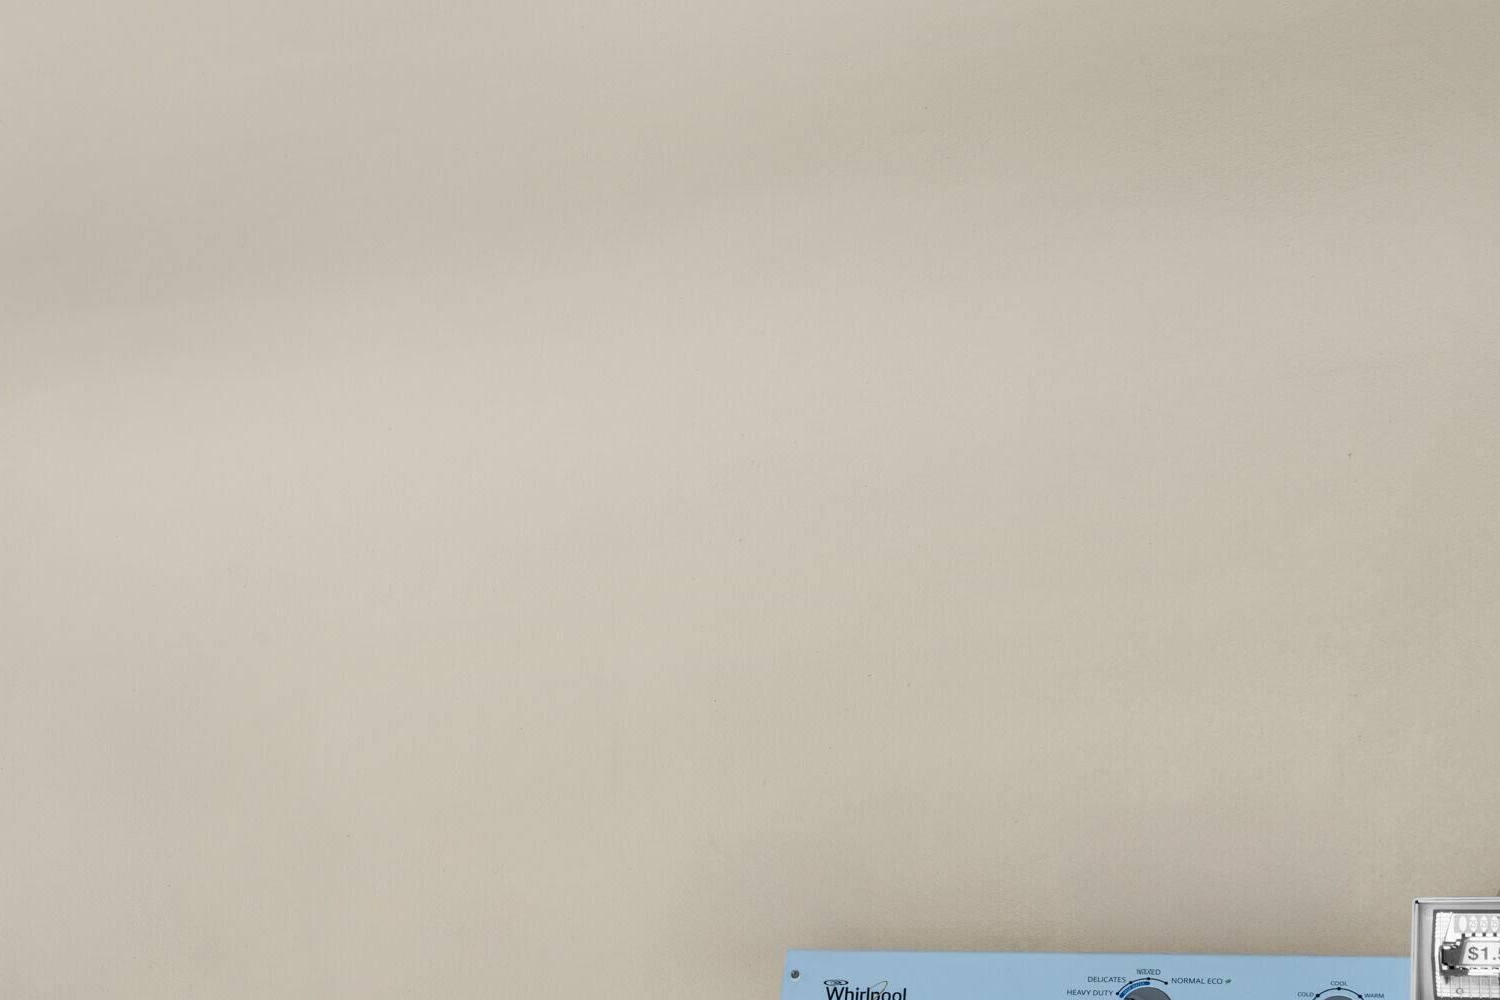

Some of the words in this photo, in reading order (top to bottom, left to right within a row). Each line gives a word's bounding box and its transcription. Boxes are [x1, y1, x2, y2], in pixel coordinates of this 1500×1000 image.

[1468, 946, 1500, 961] $1.
[1136, 968, 1161, 976] MIXED
[1171, 977, 1205, 985] NORMAL
